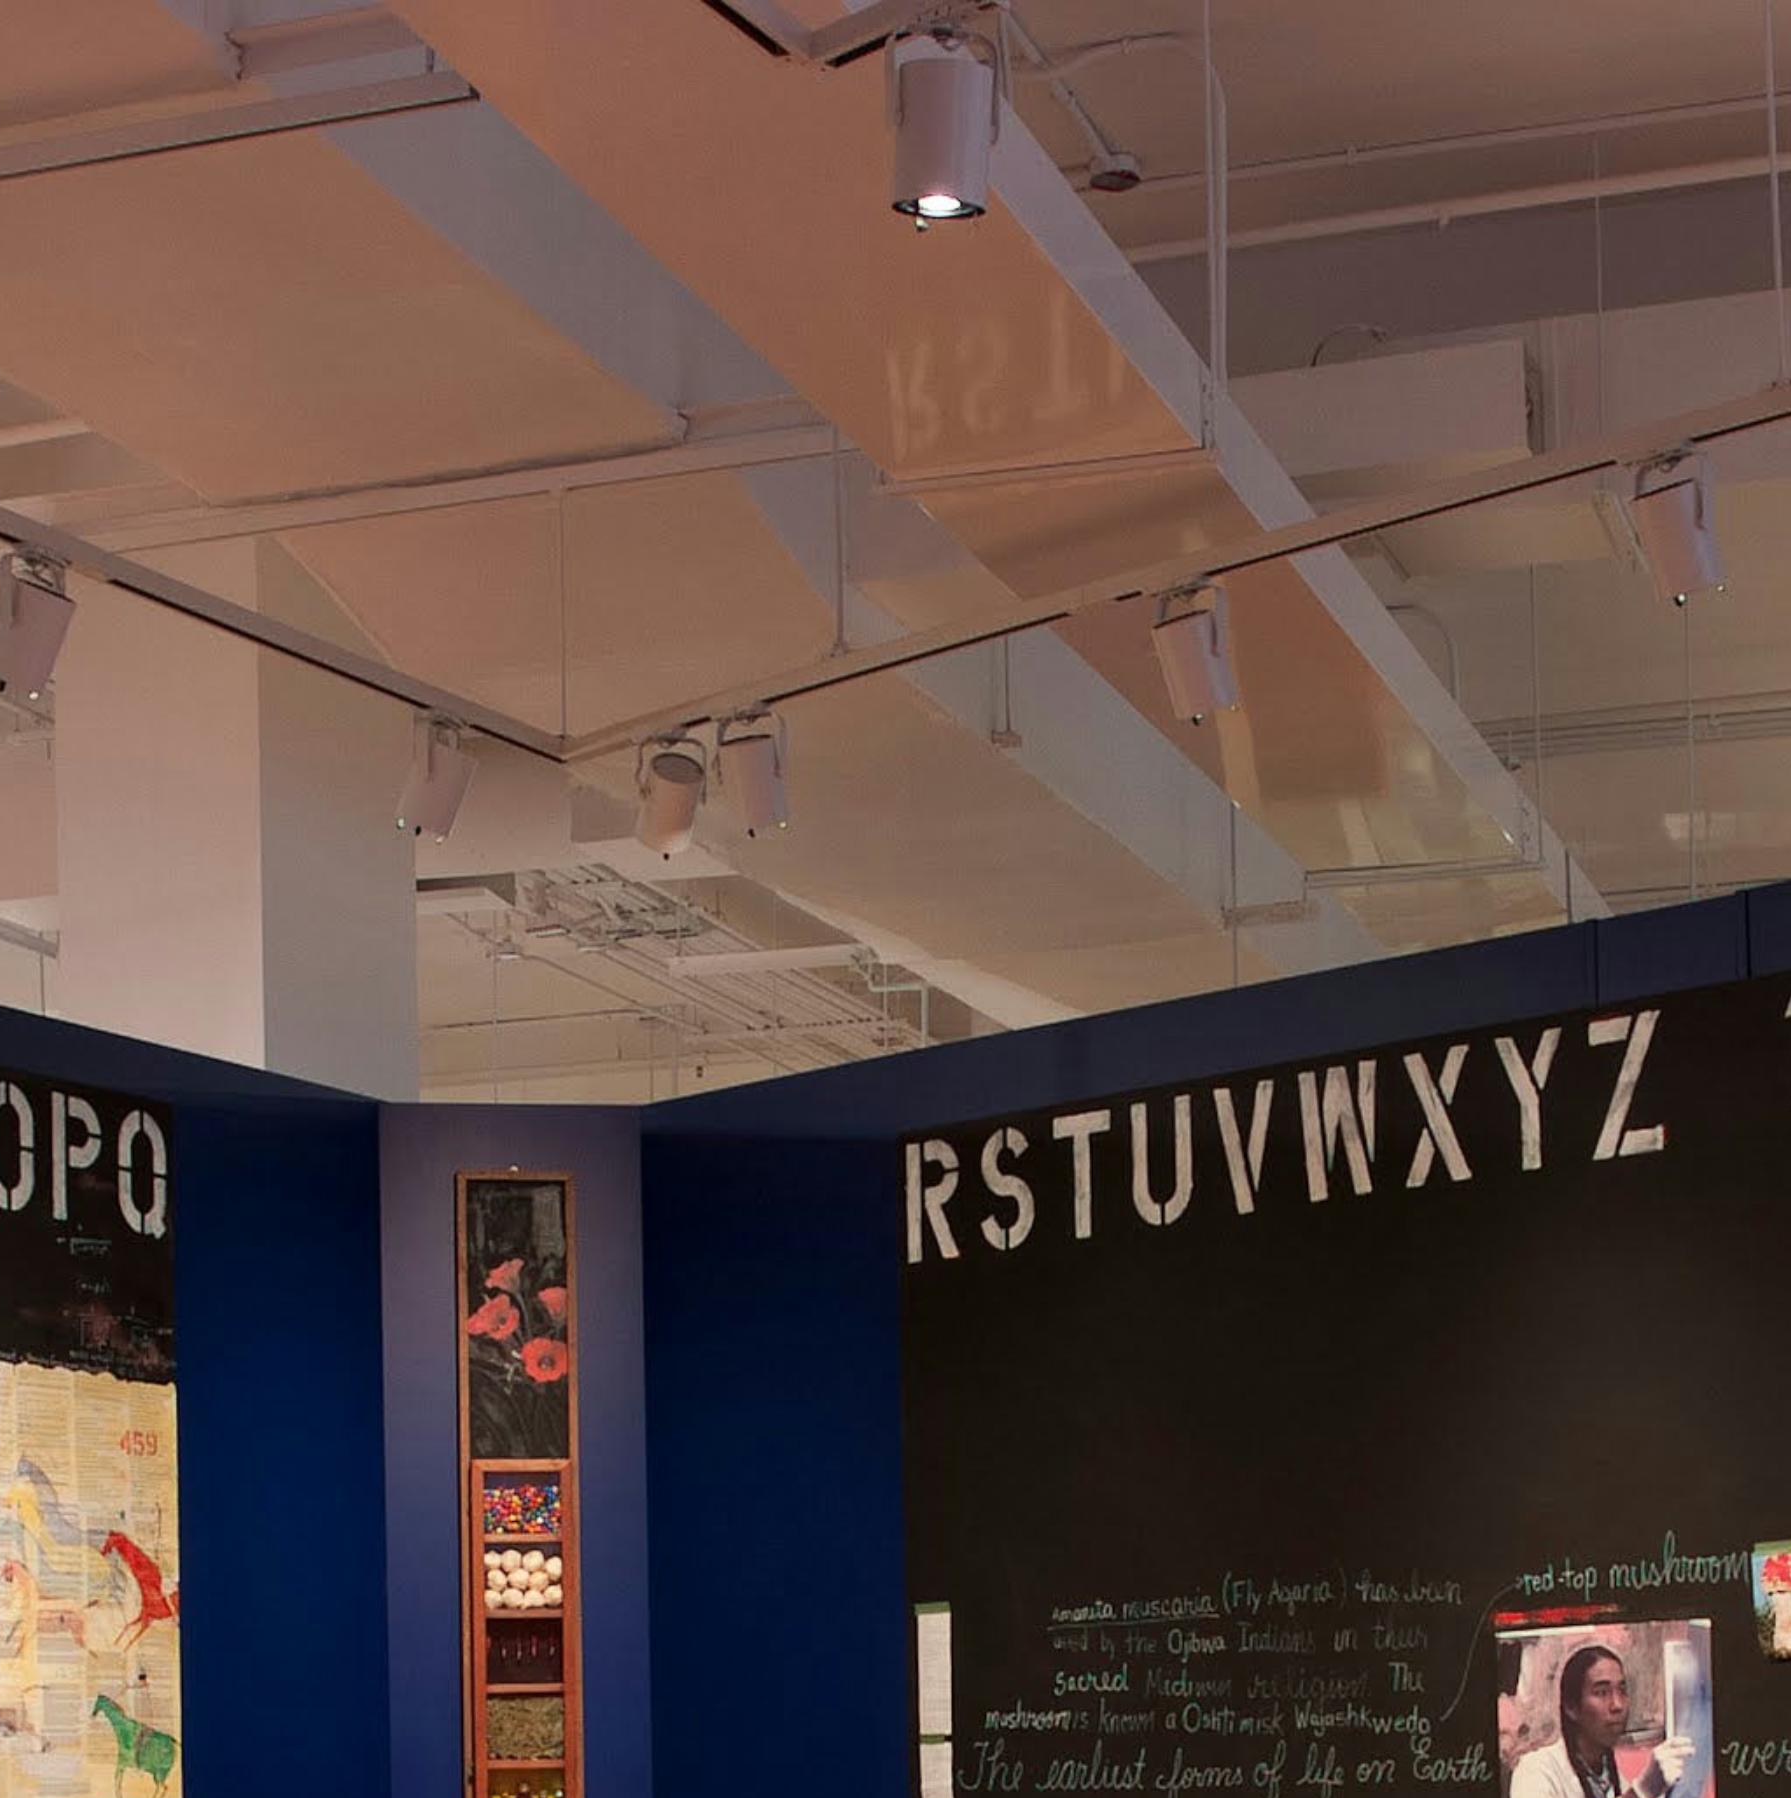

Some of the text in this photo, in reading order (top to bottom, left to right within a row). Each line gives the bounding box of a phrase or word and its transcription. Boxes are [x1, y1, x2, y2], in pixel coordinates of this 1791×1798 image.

[956, 1736, 1023, 1793] The
[1356, 1758, 1397, 1784] on
[1410, 1736, 1495, 1784] Earth
